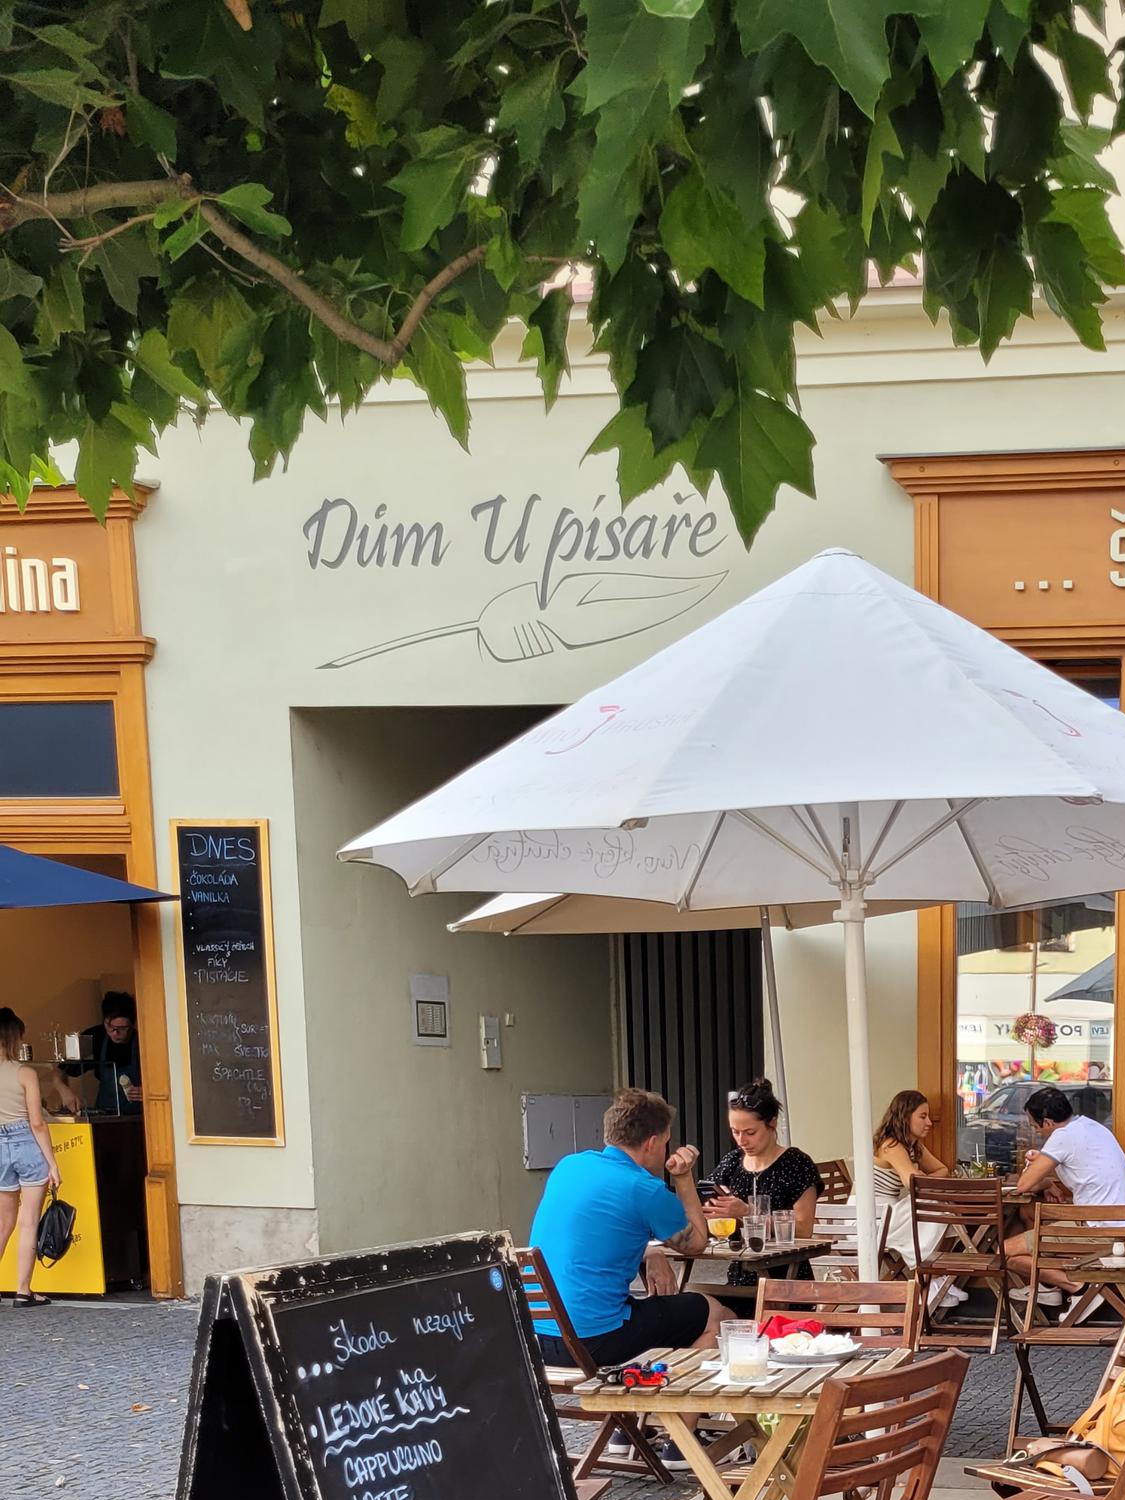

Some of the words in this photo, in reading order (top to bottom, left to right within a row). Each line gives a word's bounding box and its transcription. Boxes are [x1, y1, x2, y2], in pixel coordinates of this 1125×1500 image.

[303, 497, 451, 570] Dům
[471, 494, 542, 565] U
[538, 492, 729, 610] písaře
[186, 833, 256, 861] DNES
[191, 889, 230, 903] VANILKA
[400, 1368, 437, 1386] na
[317, 1377, 395, 1443] LEDOVÉ
[396, 1383, 447, 1418] KÁVY
[343, 1440, 443, 1488] CAPPUCCINO
